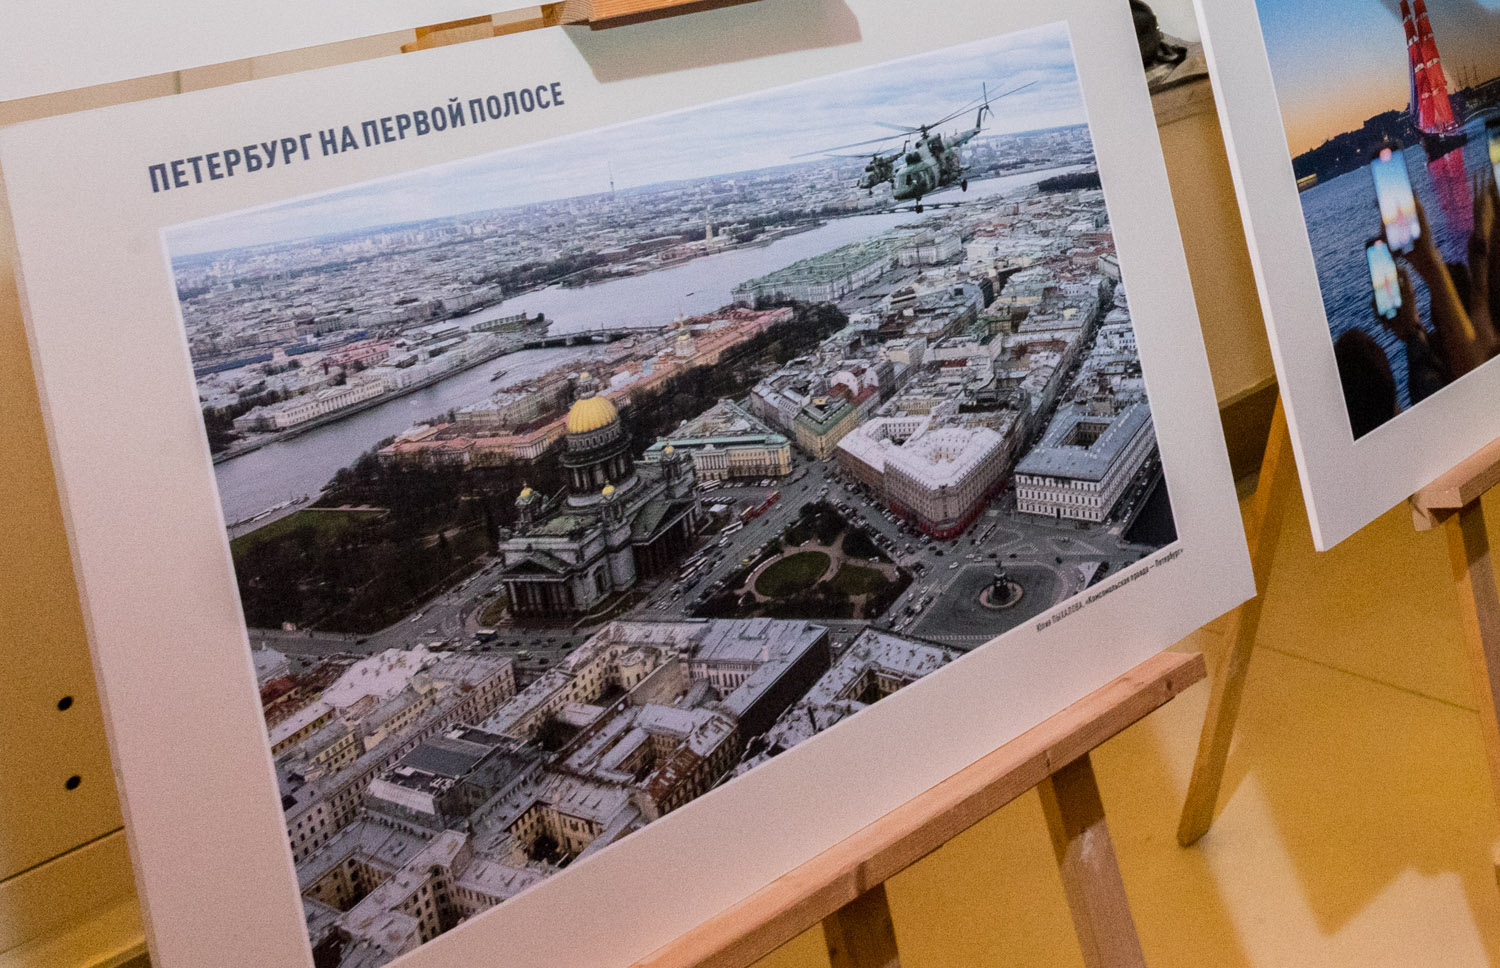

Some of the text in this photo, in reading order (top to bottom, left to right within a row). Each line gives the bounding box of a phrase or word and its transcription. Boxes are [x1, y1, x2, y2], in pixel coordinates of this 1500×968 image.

[148, 81, 565, 193] ПЕТЕРБУРГ НА ПЕРВОЙ ПОЛОСЕ
